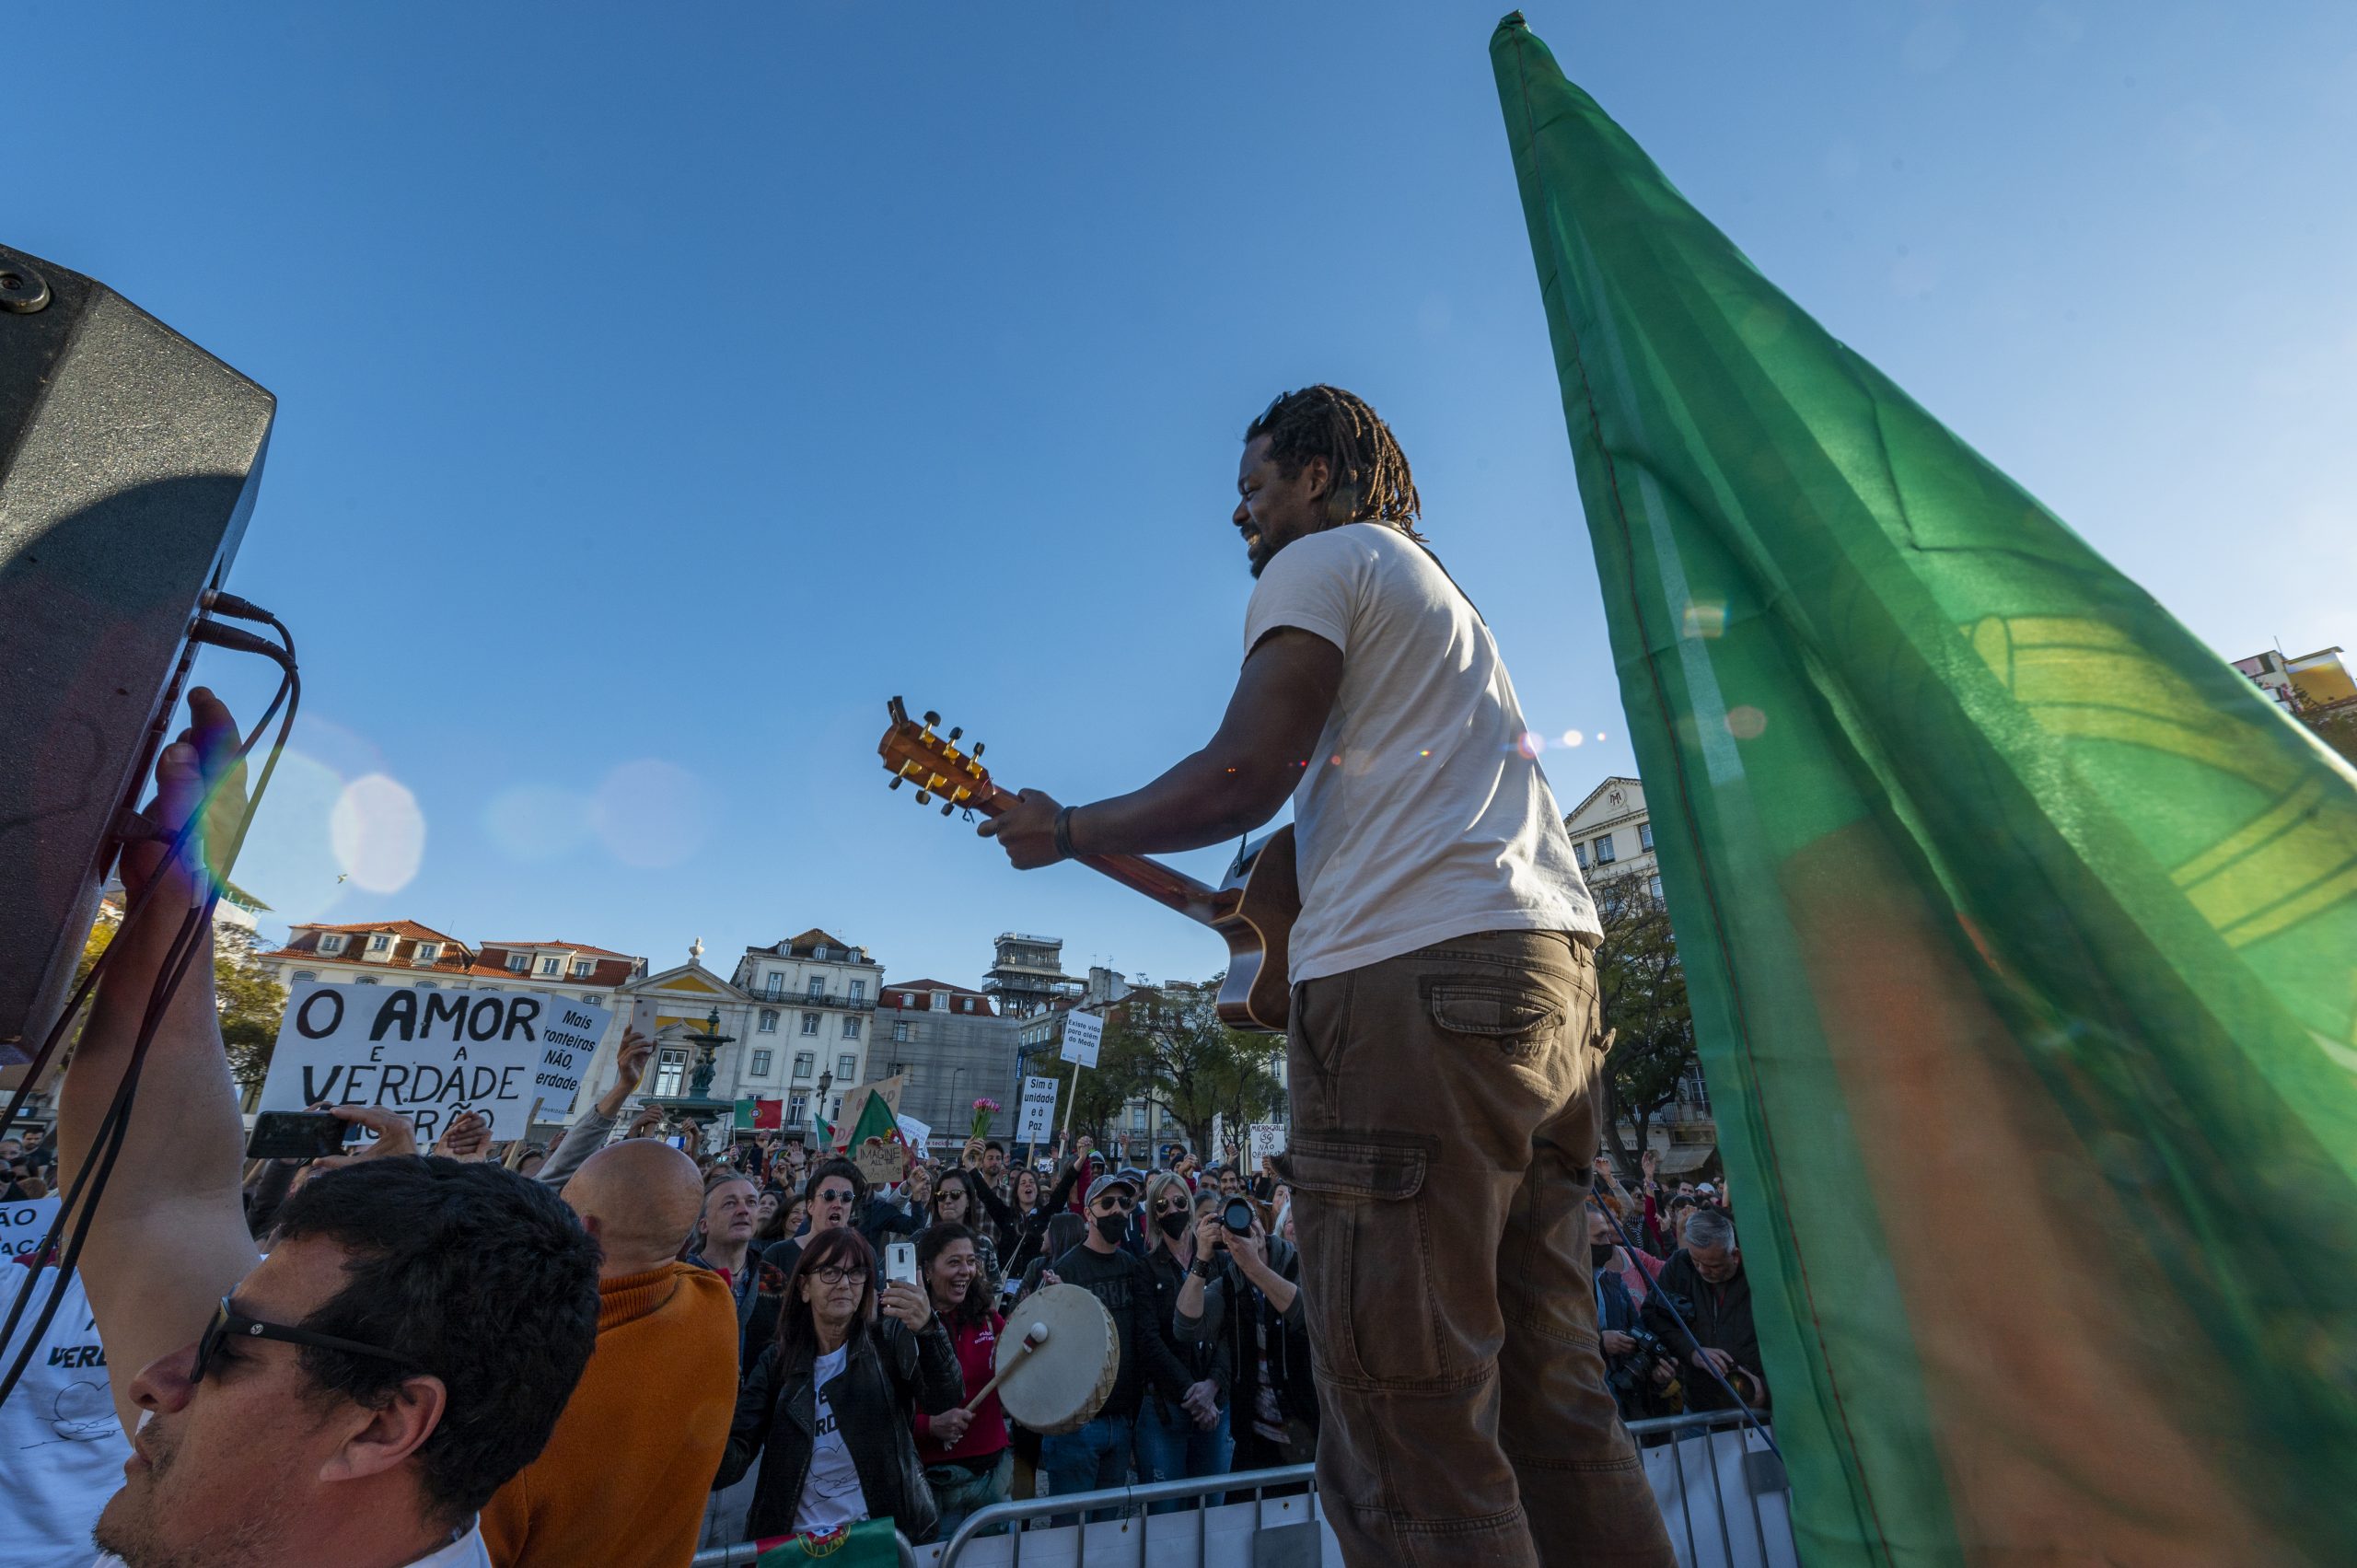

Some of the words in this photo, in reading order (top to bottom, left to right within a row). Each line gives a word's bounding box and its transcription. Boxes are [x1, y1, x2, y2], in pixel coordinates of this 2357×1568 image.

[296, 989, 344, 1040] O
[369, 989, 541, 1042] AMOR
[562, 1010, 592, 1030] Mais
[1068, 1019, 1086, 1029] Existe
[1088, 1024, 1101, 1033] vida
[543, 1027, 596, 1052] ronteiras
[1067, 1028, 1083, 1039] para
[1084, 1030, 1098, 1040] além
[1078, 1038, 1095, 1048] Medo
[453, 1046, 468, 1062] A
[544, 1049, 573, 1070] NÃO,
[536, 1072, 577, 1091] erdade
[1030, 1078, 1045, 1089] Sim
[1024, 1093, 1055, 1103] unidade
[1031, 1109, 1037, 1117] e
[1028, 1121, 1042, 1131] Paz
[860, 1147, 900, 1159] IMAGINE
